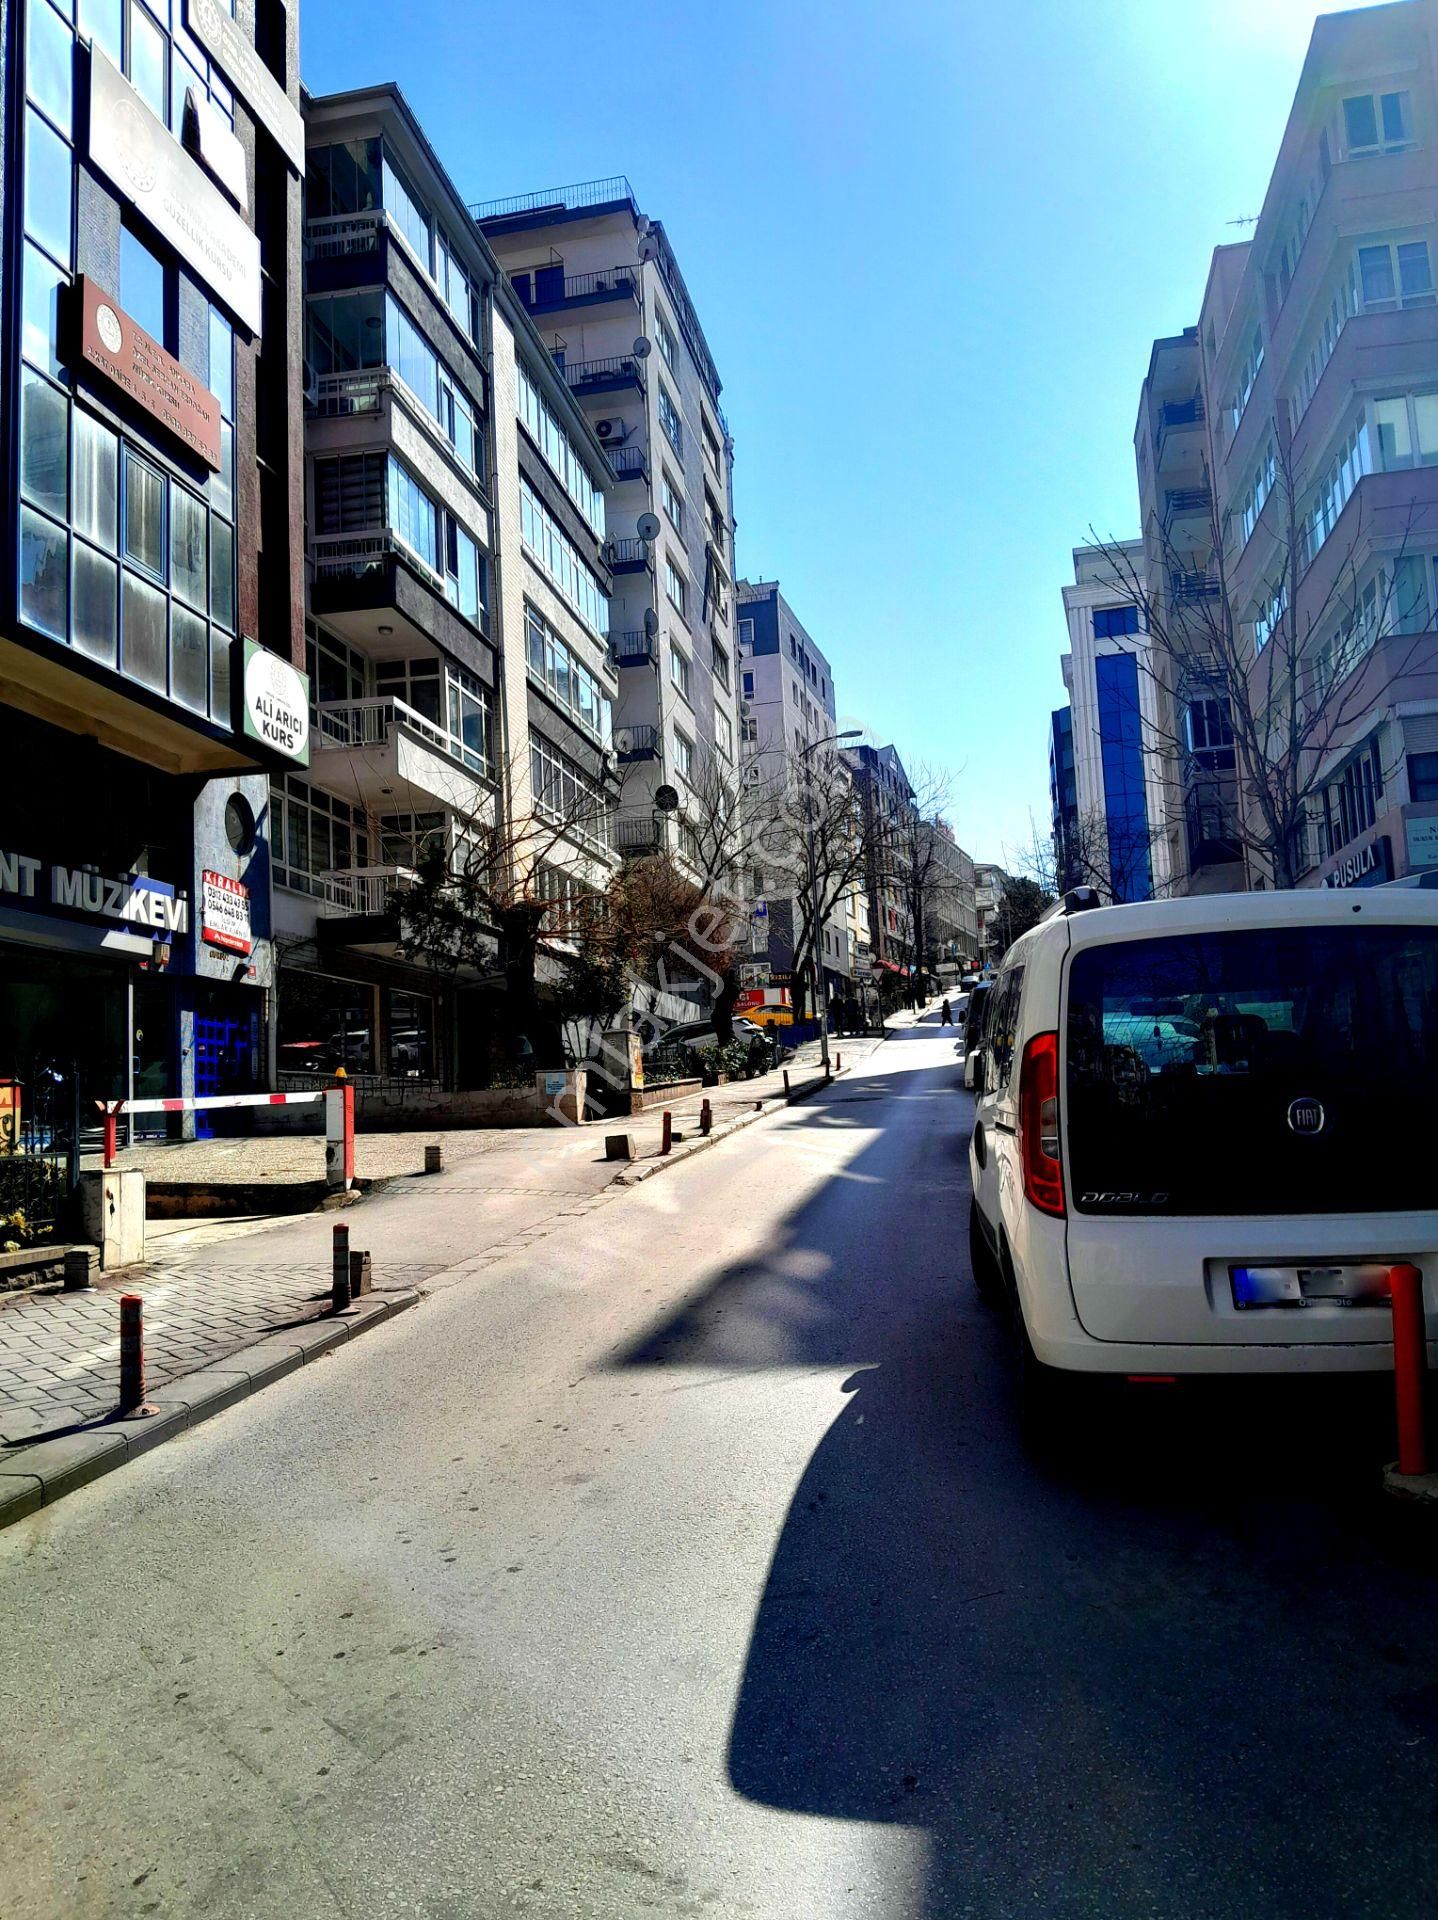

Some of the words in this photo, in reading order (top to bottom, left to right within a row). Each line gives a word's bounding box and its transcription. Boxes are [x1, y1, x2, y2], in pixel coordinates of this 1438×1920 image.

[256, 696, 272, 719] ALİ
[275, 708, 302, 735] ARICI
[262, 720, 294, 749] KURS
[1333, 845, 1375, 888] PUSULA
[1296, 1109, 1318, 1126] FIAT
[1081, 1191, 1169, 1203] DOBLO
